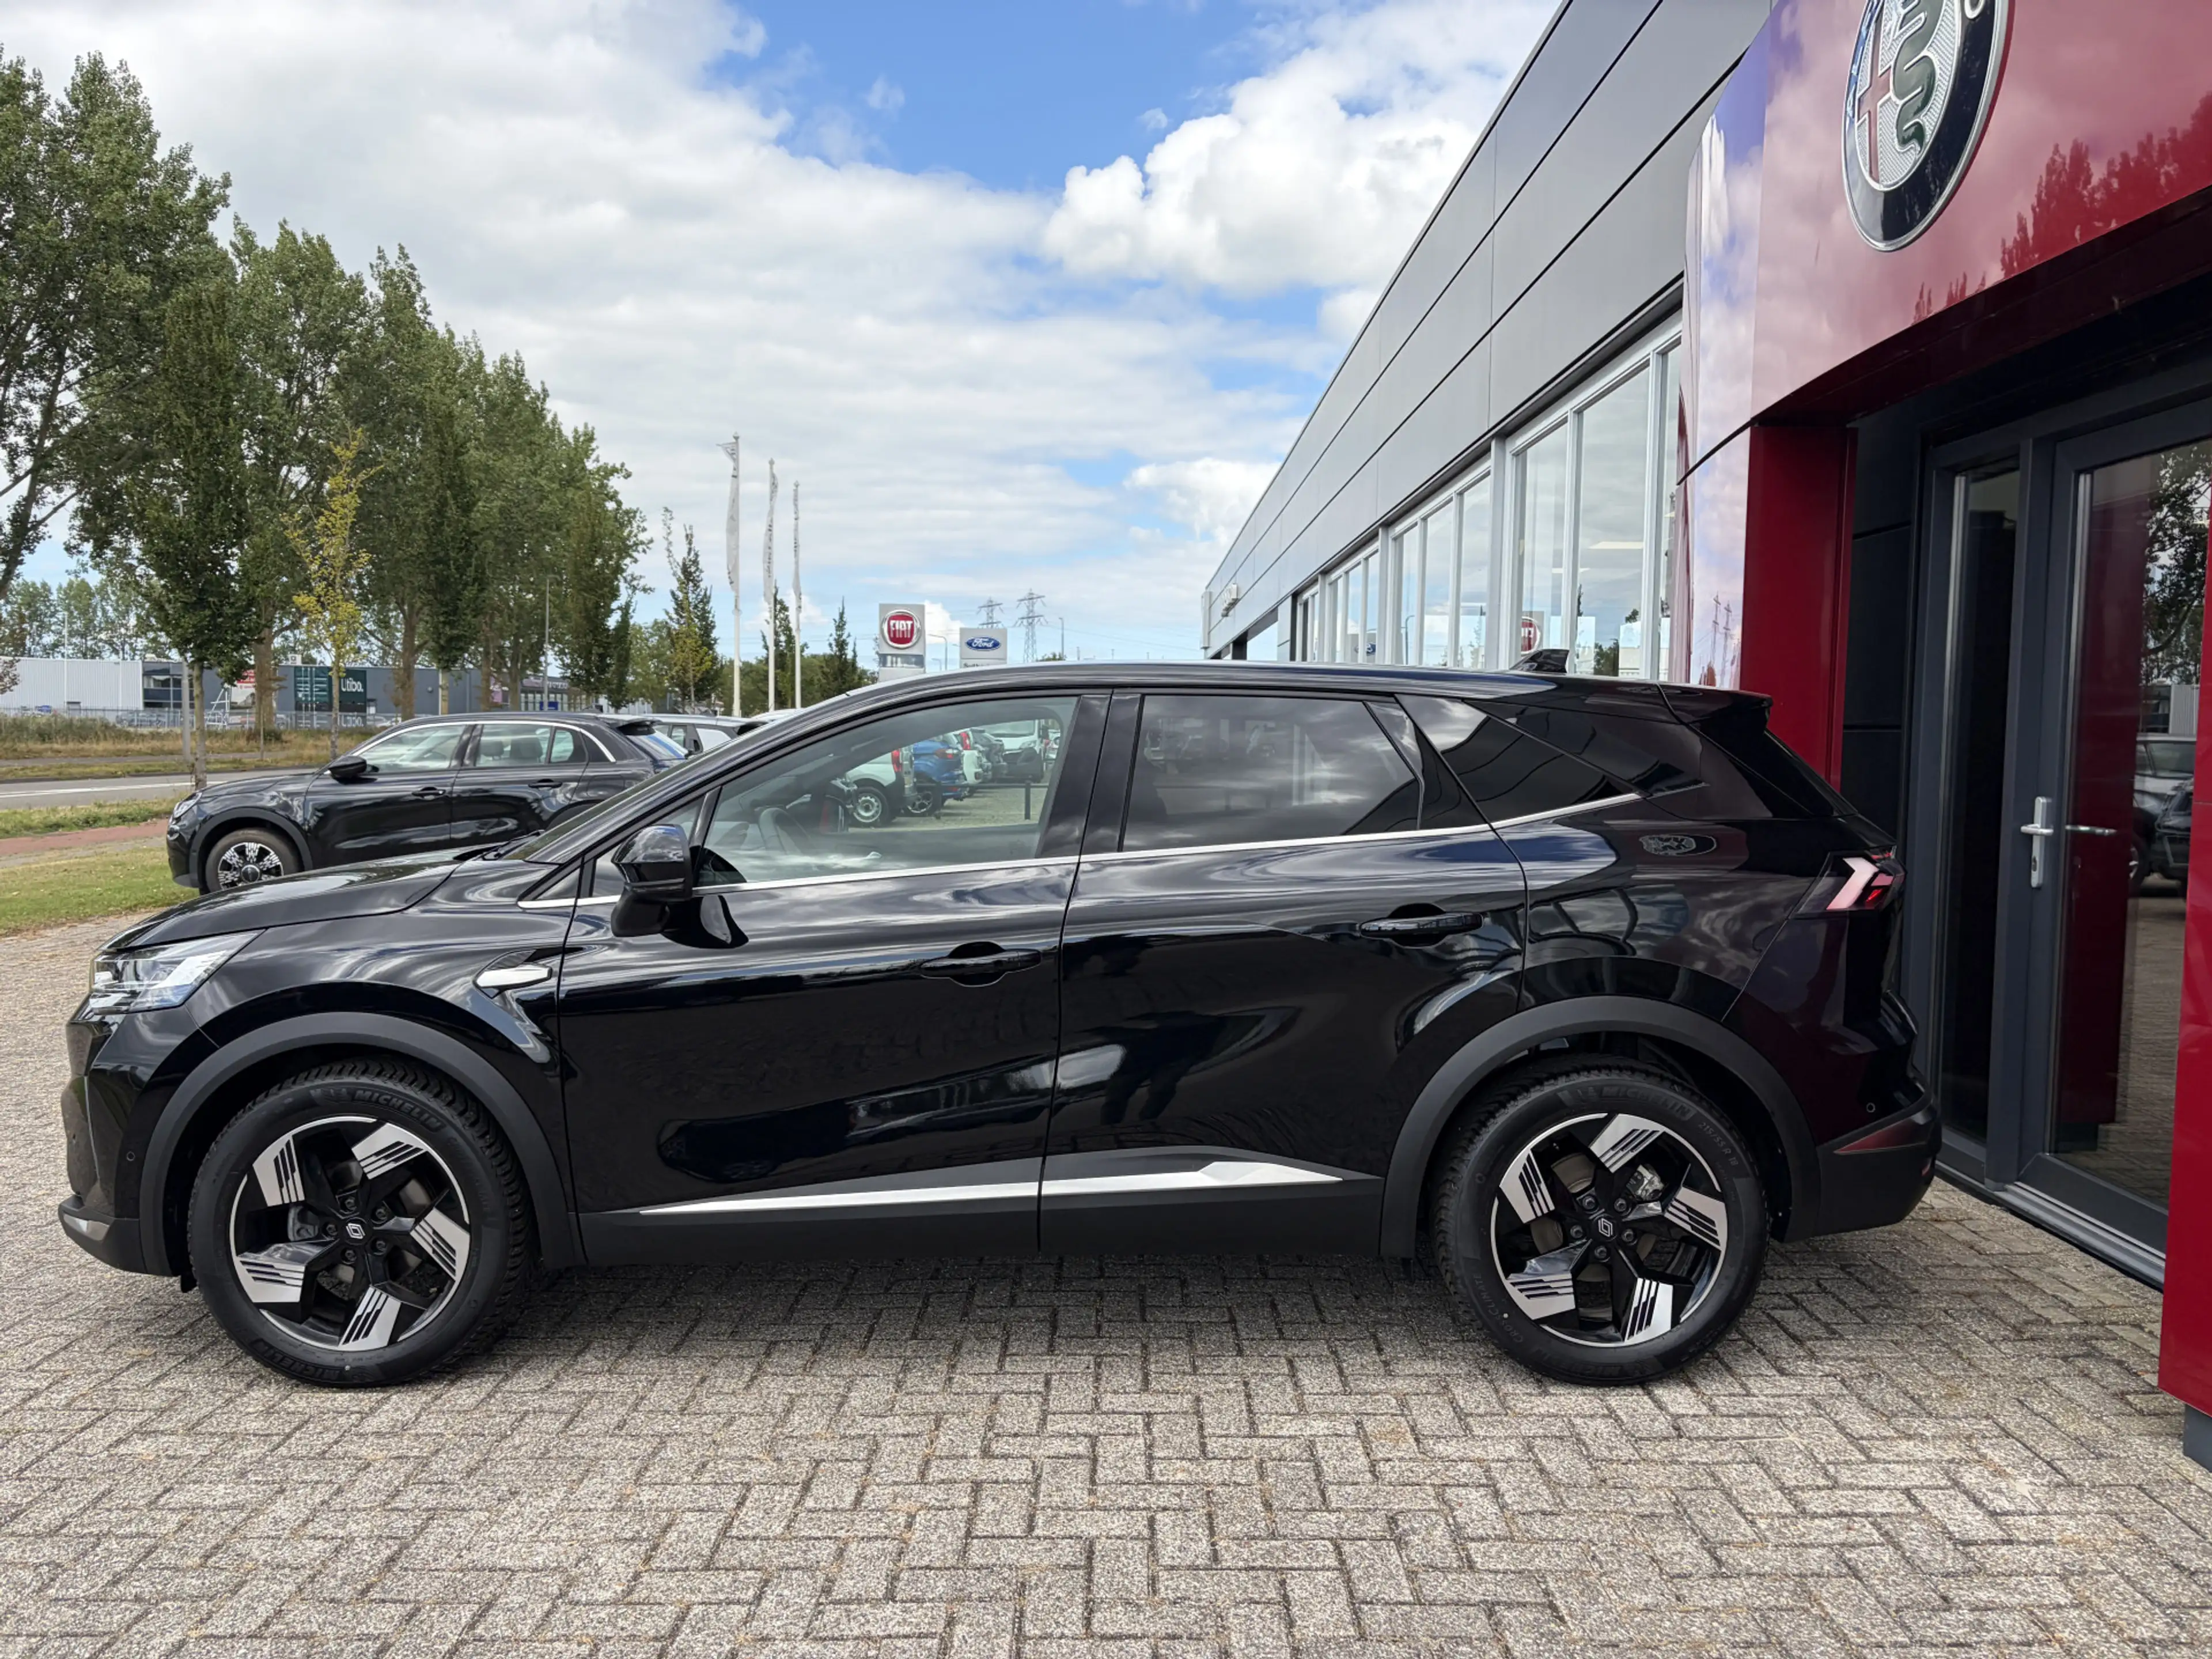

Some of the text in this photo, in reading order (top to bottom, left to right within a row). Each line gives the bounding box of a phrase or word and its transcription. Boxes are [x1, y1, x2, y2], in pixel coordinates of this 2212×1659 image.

[889, 620, 913, 638] FIAT
[972, 638, 994, 647] Ford
[355, 1090, 441, 1128] MICHELIN
[1602, 1087, 1691, 1119] MICHELIN
[1698, 1122, 1726, 1148] 215/55
[1728, 1157, 1738, 1166] 18
